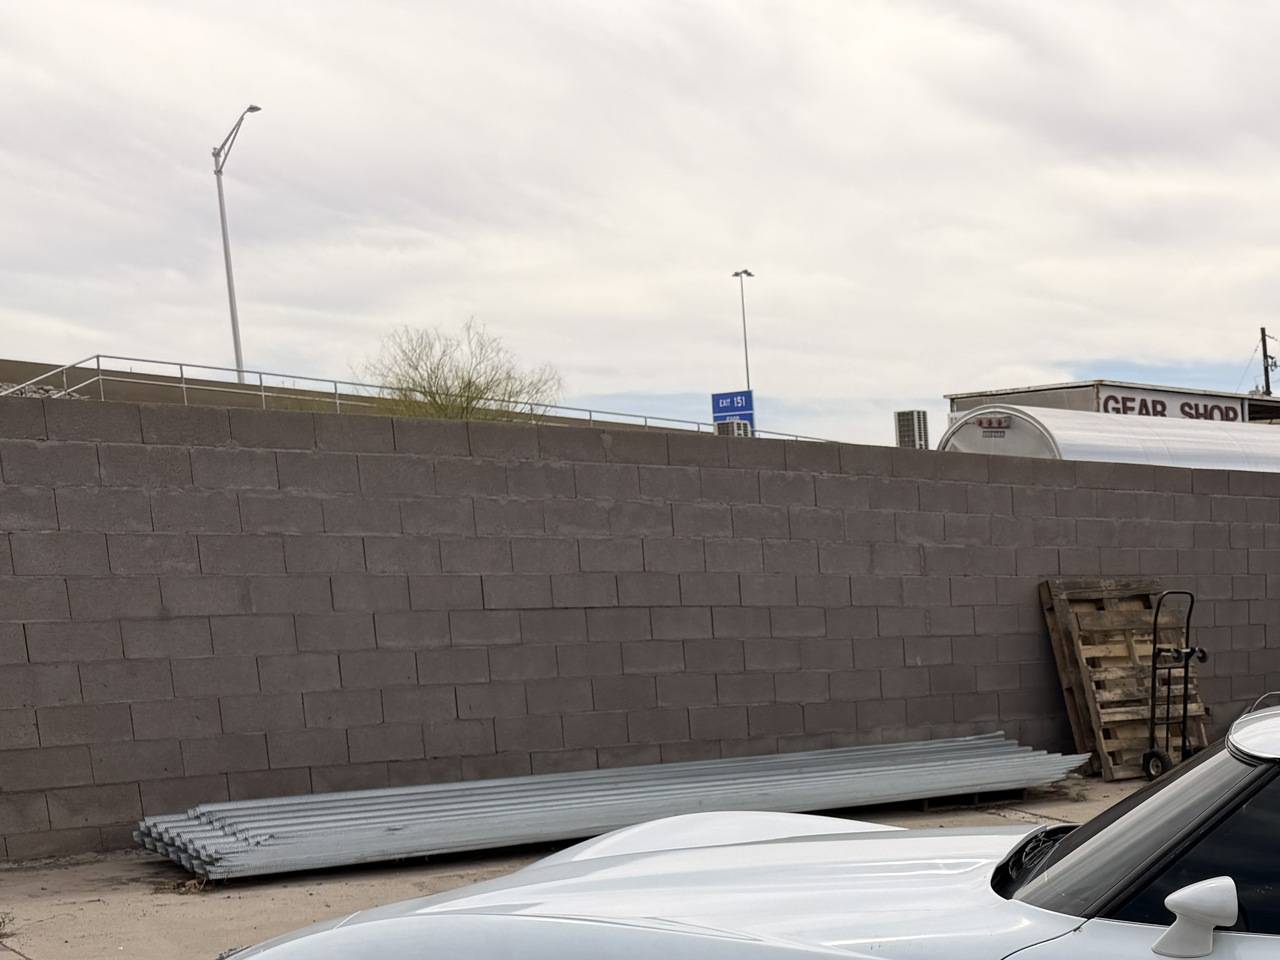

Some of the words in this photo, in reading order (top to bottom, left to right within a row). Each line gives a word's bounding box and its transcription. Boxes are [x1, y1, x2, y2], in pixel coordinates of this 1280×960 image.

[734, 396, 745, 407] 151
[1103, 395, 1168, 418] GEAR
[1180, 402, 1239, 422] SHOP
